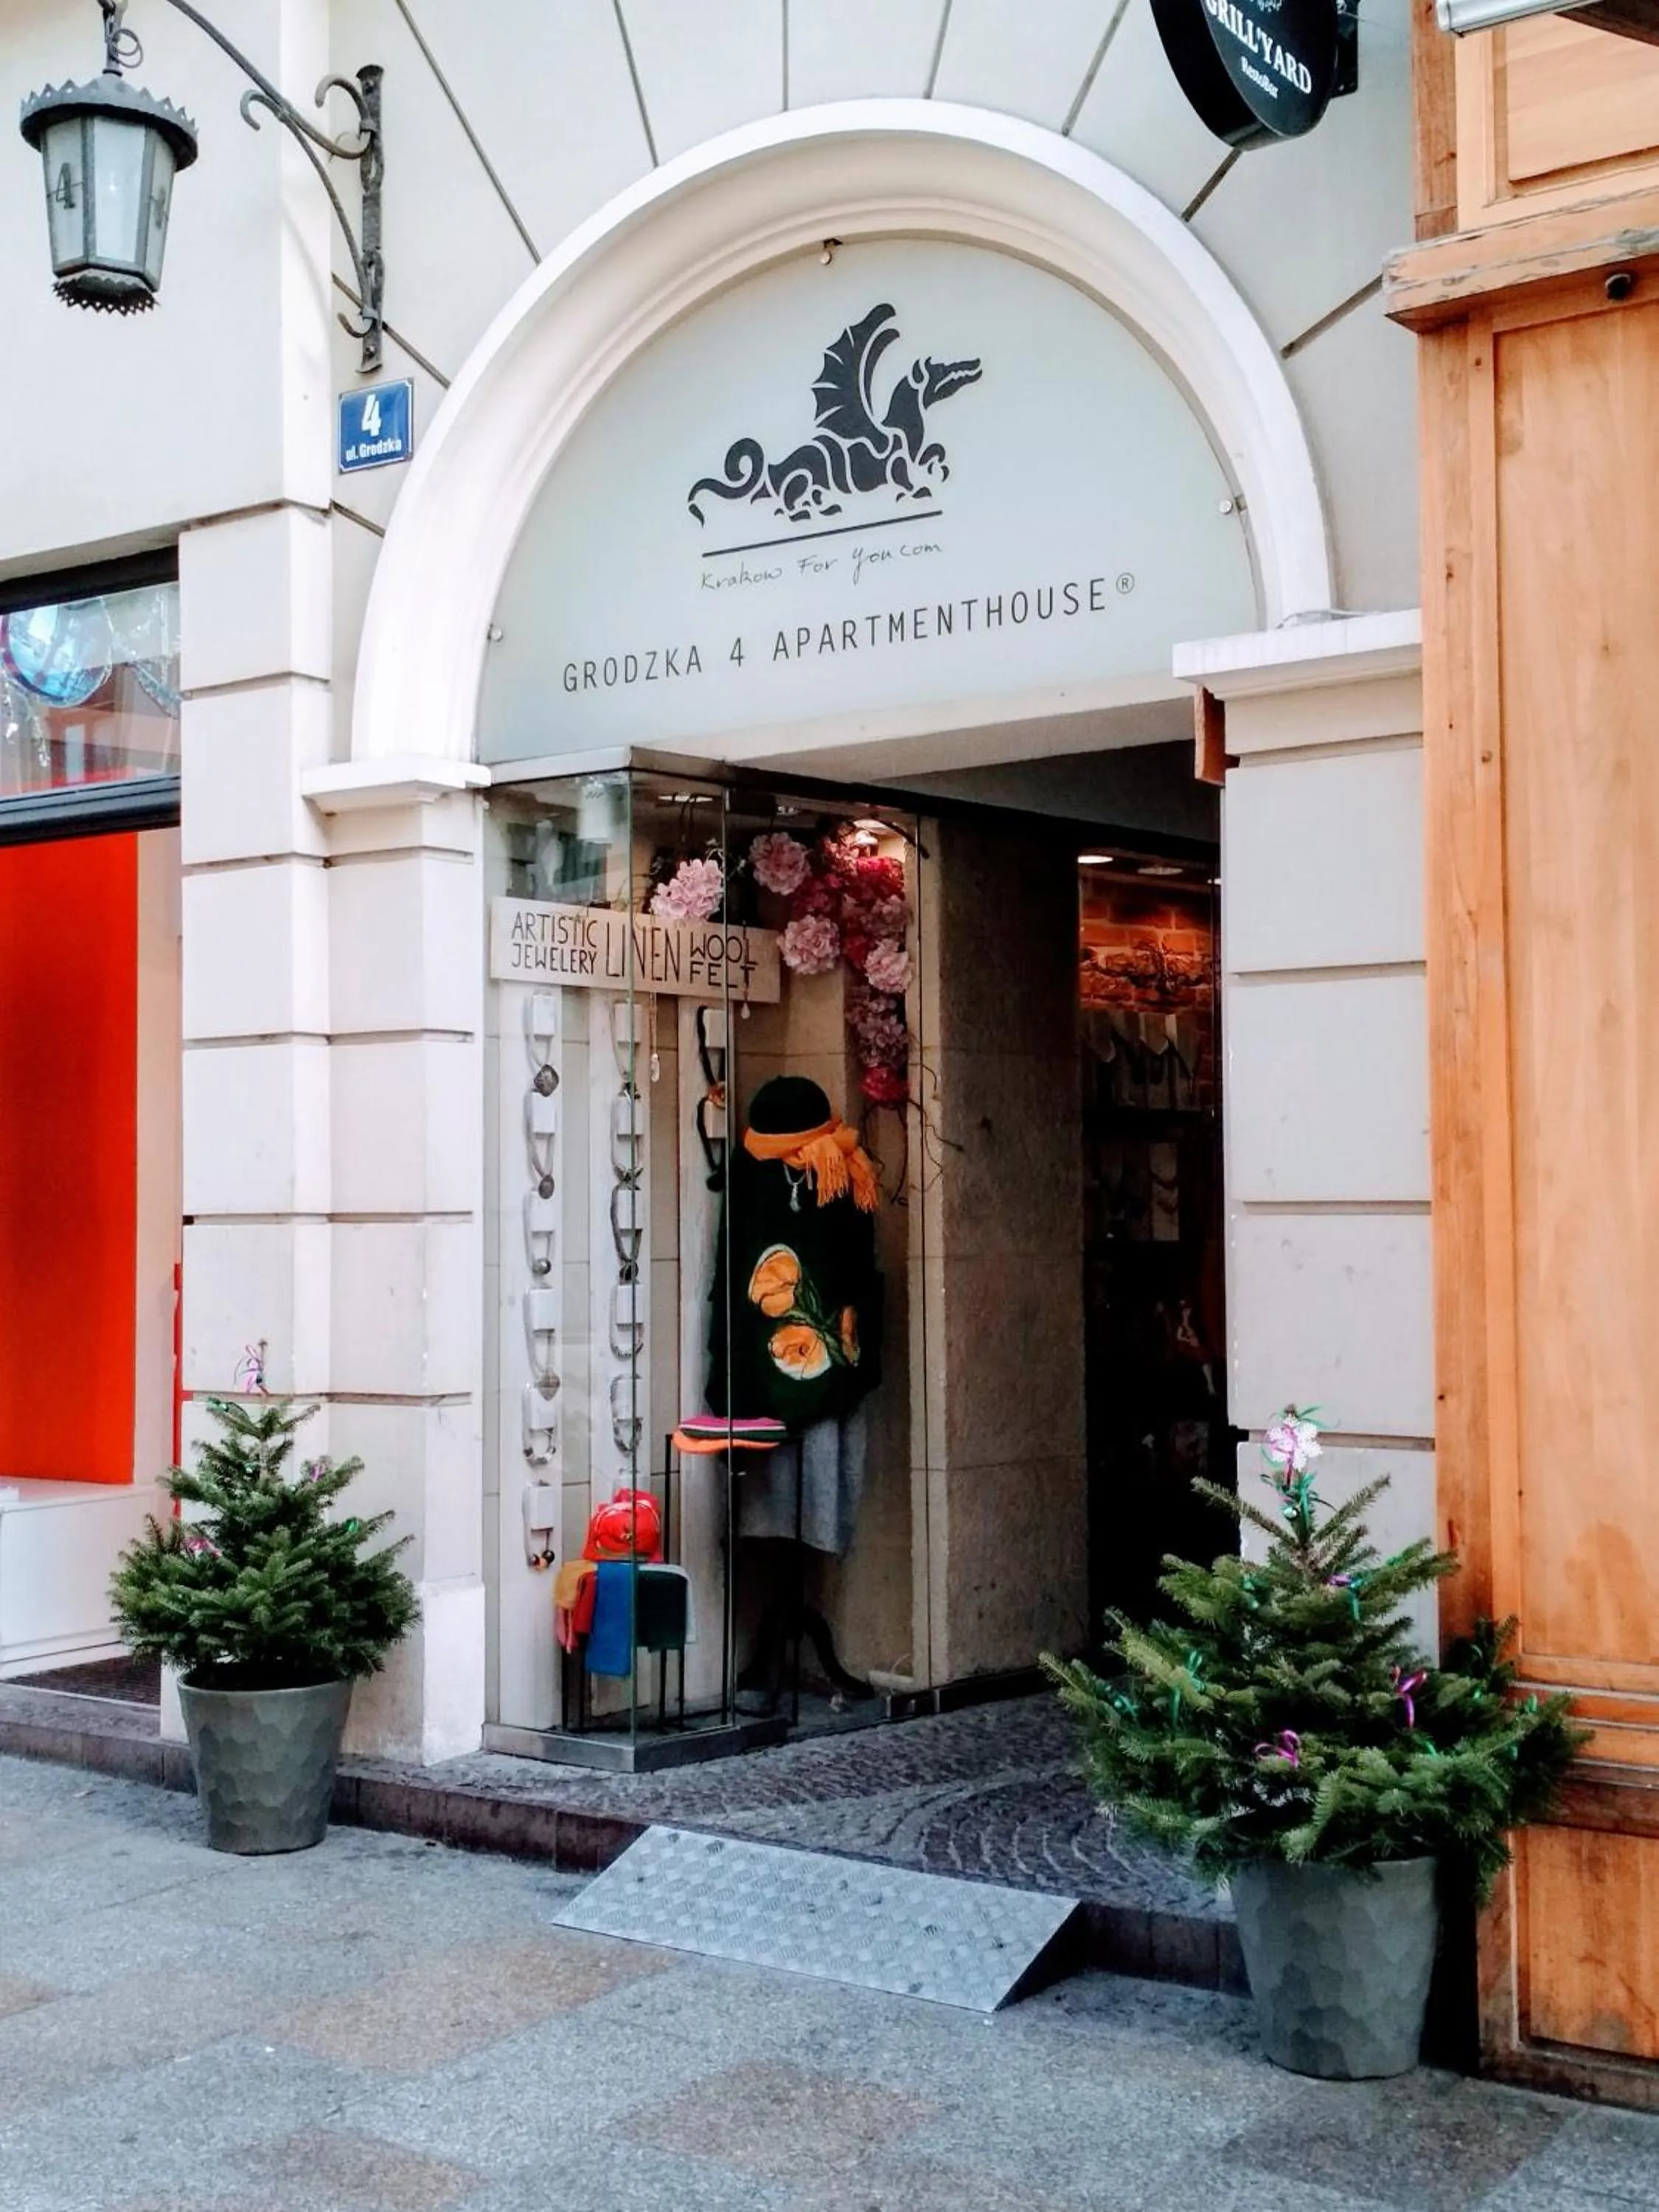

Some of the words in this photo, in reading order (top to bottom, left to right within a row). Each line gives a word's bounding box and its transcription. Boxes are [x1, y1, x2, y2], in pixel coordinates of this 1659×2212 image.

[56, 163, 75, 209] 4
[362, 394, 381, 437] 4
[346, 445, 358, 461] ul.
[359, 437, 402, 458] Grodzka
[702, 562, 782, 589] Krakow
[798, 554, 838, 574] For
[563, 645, 703, 693] GRODZKA
[729, 637, 745, 667] 4
[511, 911, 598, 949] ARTISTIC
[689, 931, 759, 966] WOOL
[511, 942, 598, 975] JEWELERY
[605, 921, 681, 984] LINEN
